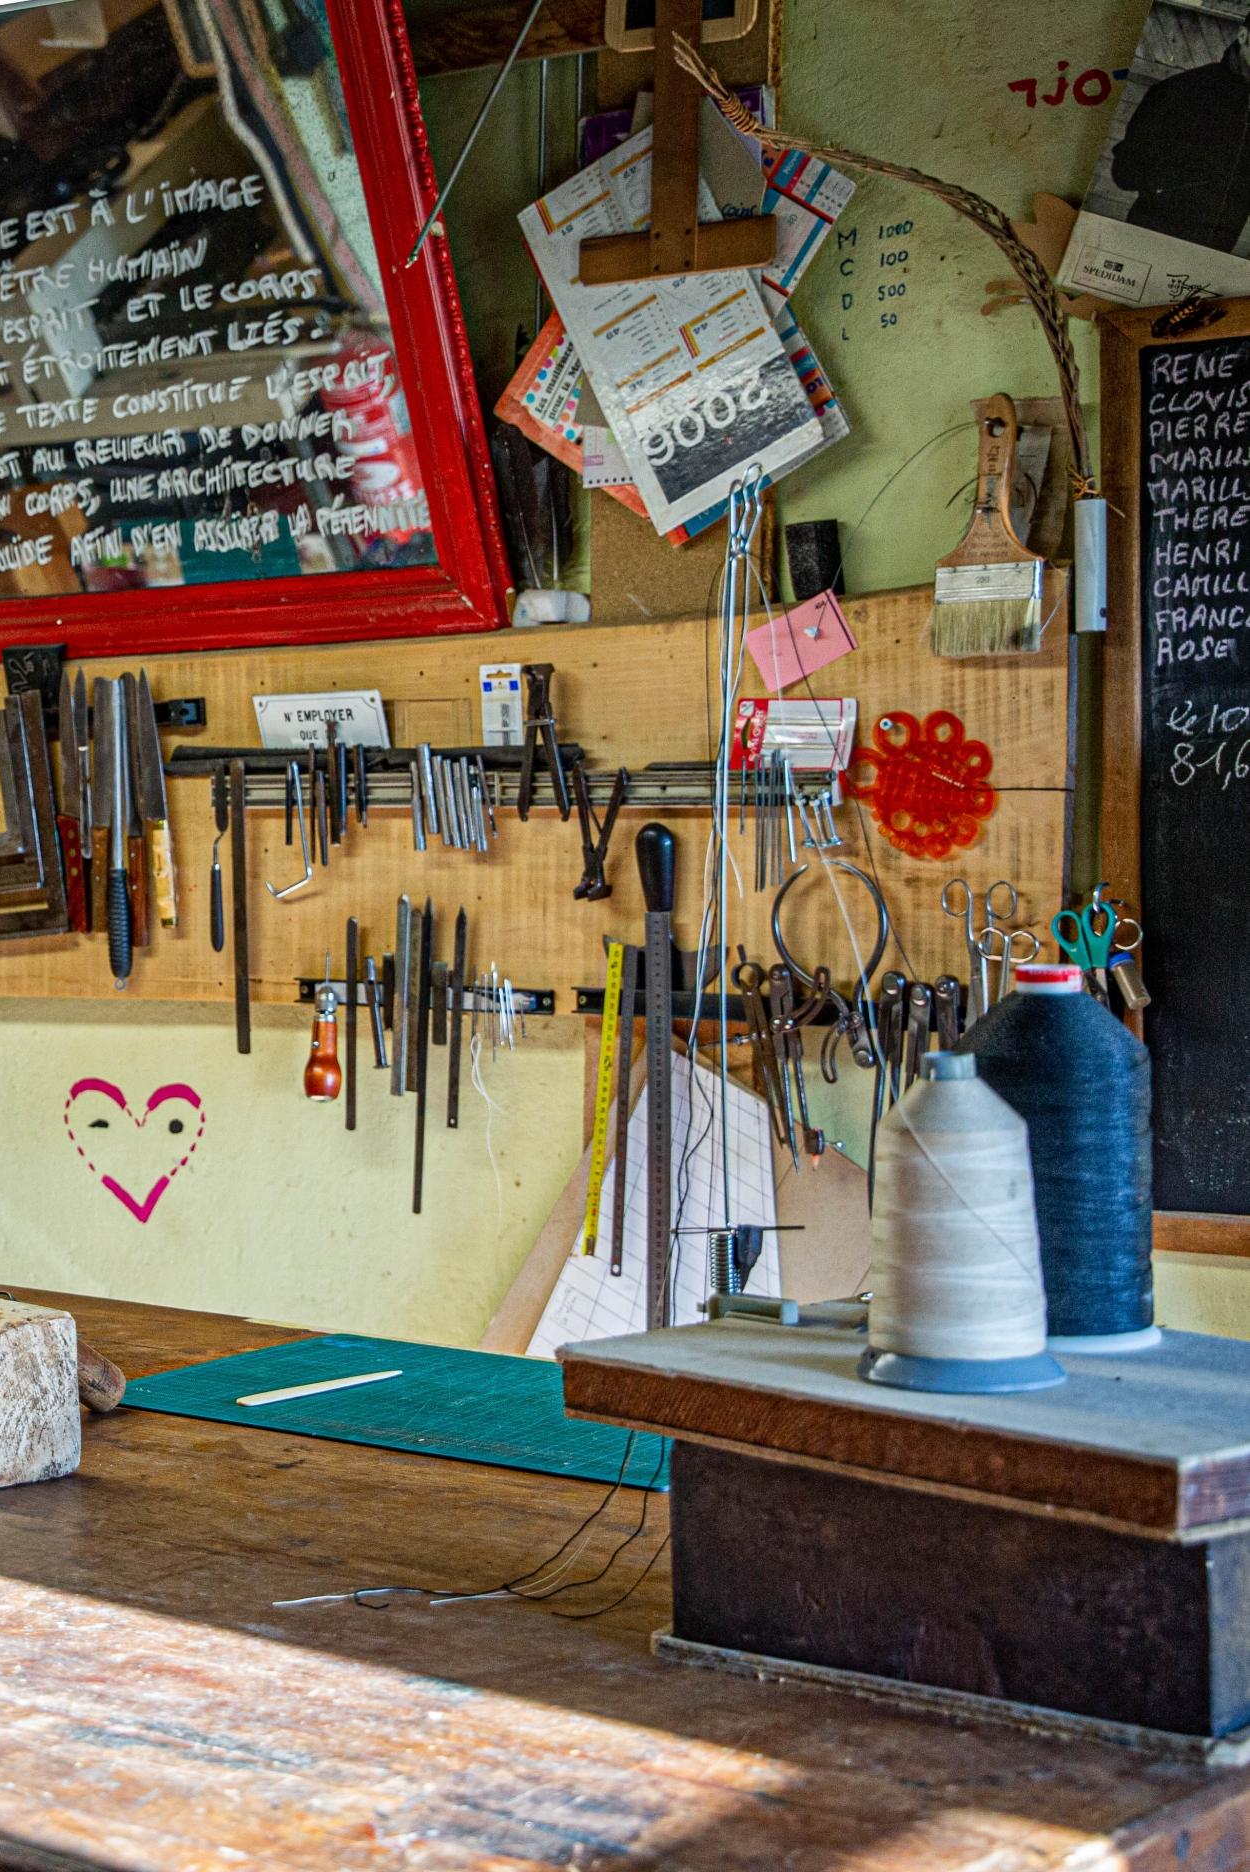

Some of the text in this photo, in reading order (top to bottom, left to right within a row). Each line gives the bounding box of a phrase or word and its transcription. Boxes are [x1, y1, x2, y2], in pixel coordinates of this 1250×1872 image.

[26, 202, 81, 242] EST
[837, 220, 914, 250] M 1000
[87, 238, 208, 283] HUMAIN
[840, 250, 909, 277] C 100
[1083, 264, 1137, 288] SPEDIDAM
[126, 292, 166, 323] ET
[179, 284, 214, 311] LE
[220, 267, 323, 304] CORPS
[842, 282, 906, 311] D 500
[842, 313, 898, 341] L 50
[22, 329, 219, 385] ÉTROITEMENT
[1151, 353, 1239, 385] RENE
[15, 396, 100, 430] TEXTE
[1150, 380, 1250, 415] CLOVIS
[641, 366, 770, 467] 2006
[1150, 411, 1250, 447] PIERRE
[31, 446, 68, 475] AU
[199, 424, 234, 455] DE
[241, 409, 357, 452] DONNER
[110, 473, 155, 505] UNE
[156, 451, 358, 498] ARCHITECTURE
[70, 525, 124, 568] AFIN
[1154, 538, 1240, 569] HENRI
[1153, 571, 1250, 598] CAMILL
[1157, 635, 1232, 667] ROSE
[296, 708, 355, 723] EMPLOYER
[1208, 704, 1250, 734] 10
[299, 730, 319, 742] QUE
